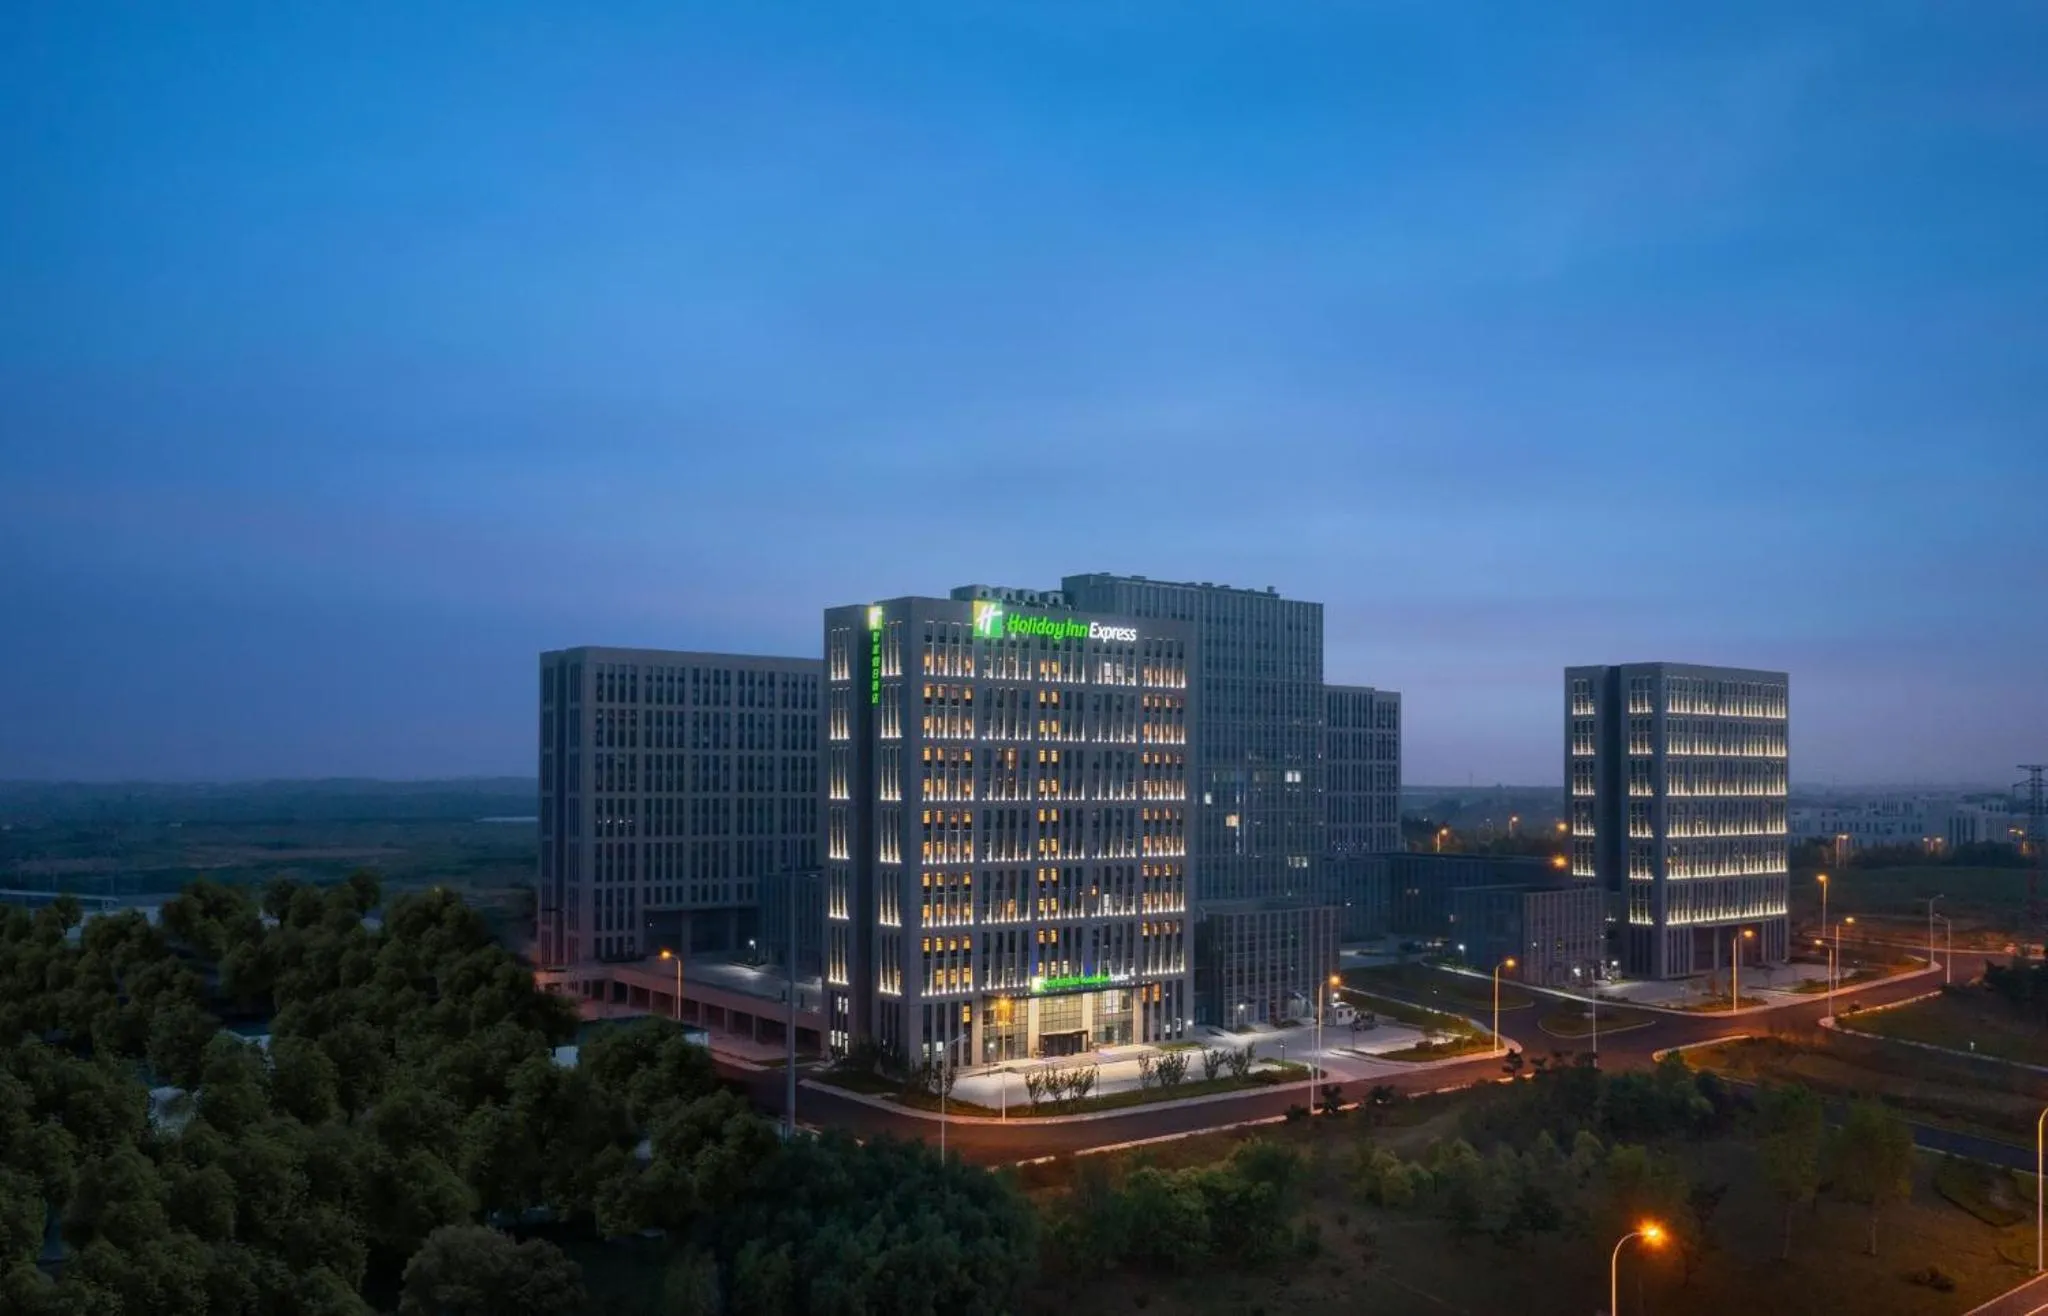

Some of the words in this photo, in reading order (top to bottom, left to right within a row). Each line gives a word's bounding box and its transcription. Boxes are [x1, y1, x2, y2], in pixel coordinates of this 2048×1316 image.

[1007, 613, 1065, 639] Holiday
[1066, 617, 1088, 638] Inn
[1089, 621, 1137, 643] Express
